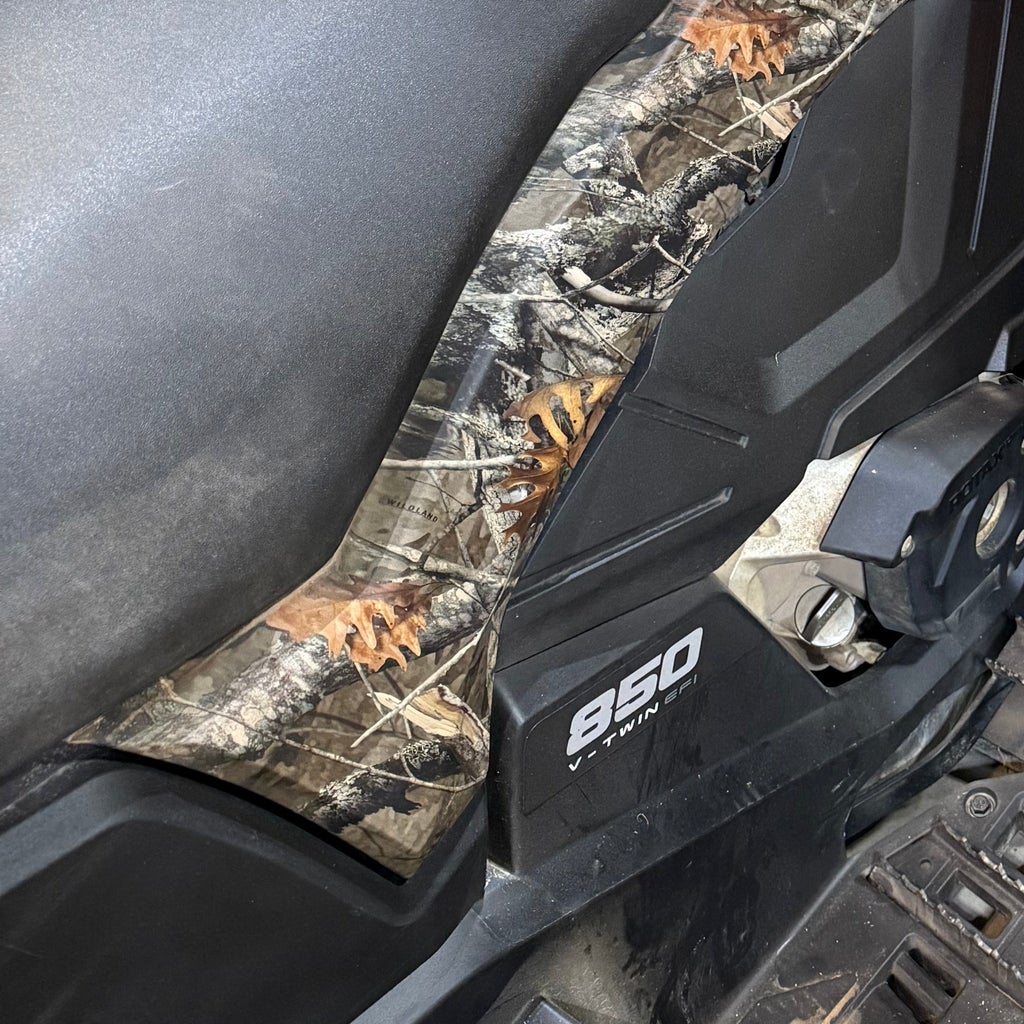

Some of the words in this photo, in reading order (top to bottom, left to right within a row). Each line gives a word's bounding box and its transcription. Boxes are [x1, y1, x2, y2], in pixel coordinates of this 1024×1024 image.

[387, 497, 439, 523] WILDLAND
[566, 626, 704, 757] 850
[664, 673, 698, 705] EFI
